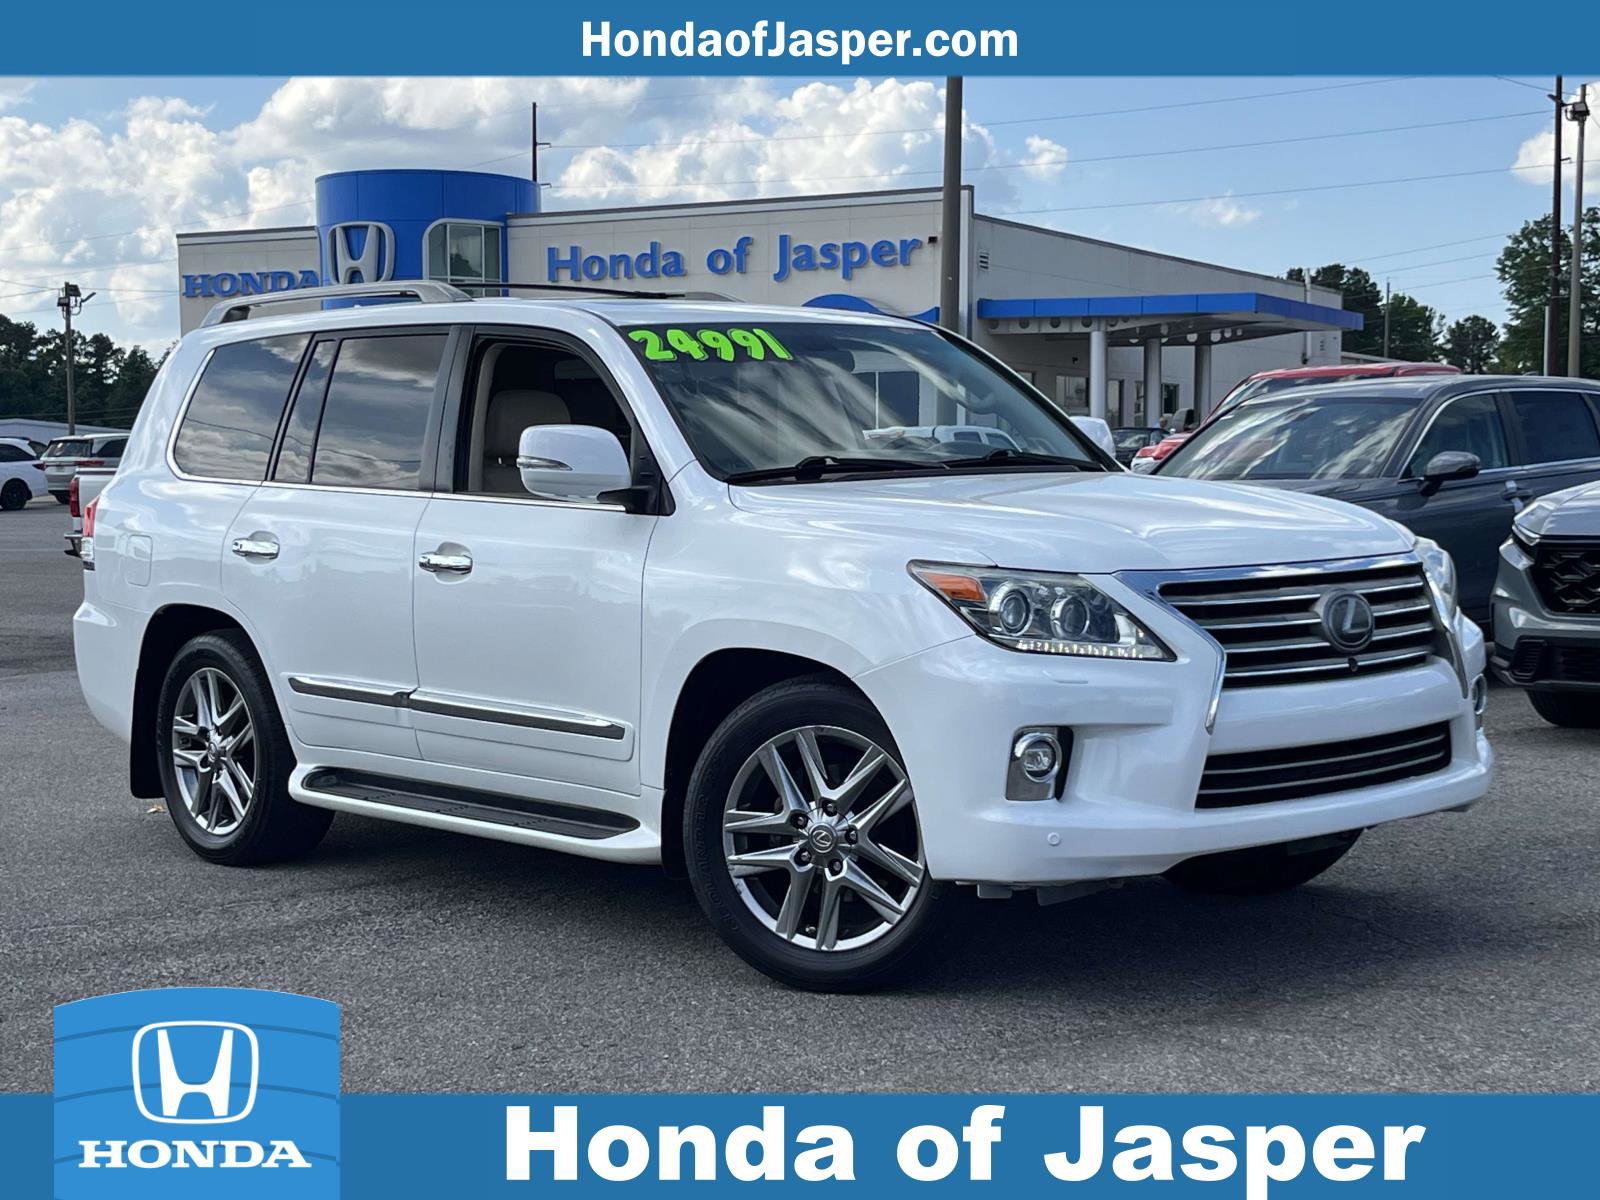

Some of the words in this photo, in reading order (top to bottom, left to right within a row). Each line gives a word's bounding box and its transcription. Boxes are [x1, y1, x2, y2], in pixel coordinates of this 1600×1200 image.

[547, 241, 687, 282] Honda
[706, 236, 754, 274] of
[773, 234, 922, 282] Jasper
[182, 270, 321, 298] HONDA
[628, 328, 793, 362] 24991
